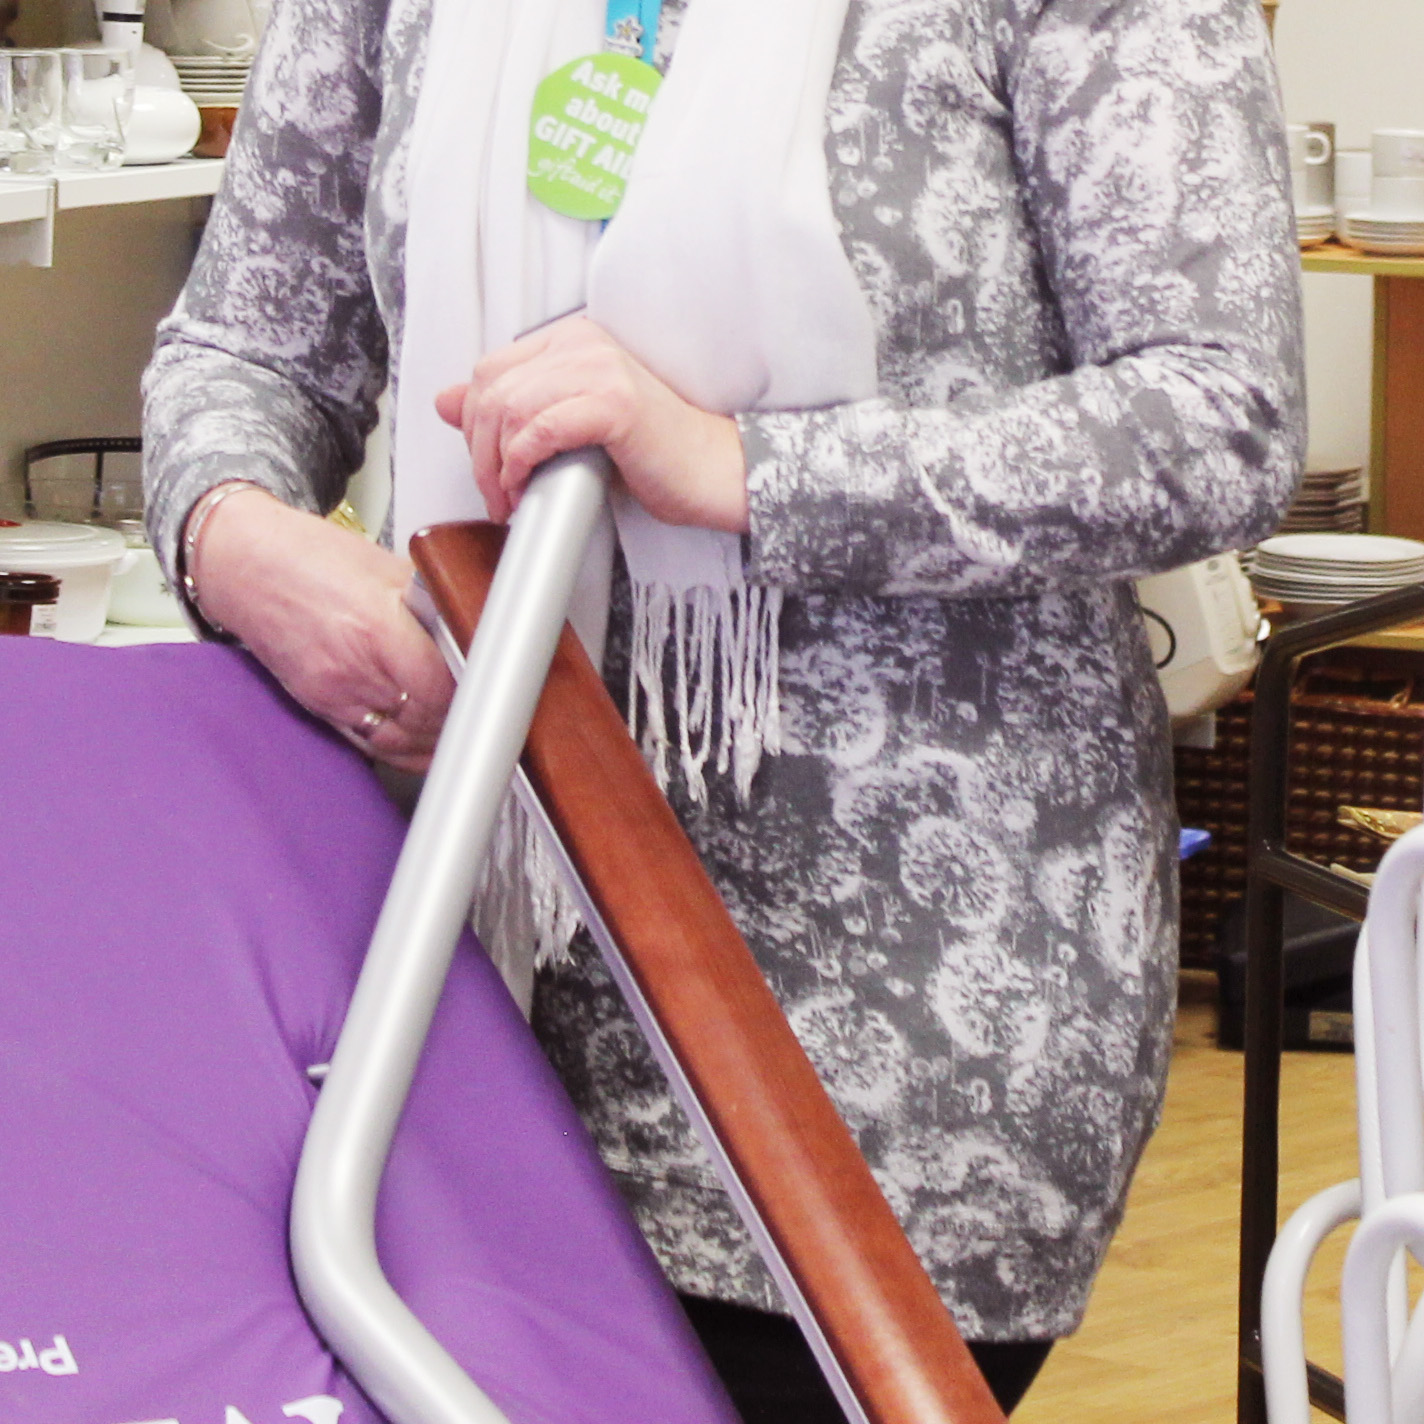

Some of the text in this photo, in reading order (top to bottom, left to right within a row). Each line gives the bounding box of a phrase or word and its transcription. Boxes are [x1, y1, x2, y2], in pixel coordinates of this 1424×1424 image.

[571, 60, 652, 115] Ask m
[534, 115, 631, 178] GIFT AI
[564, 96, 641, 147] about
